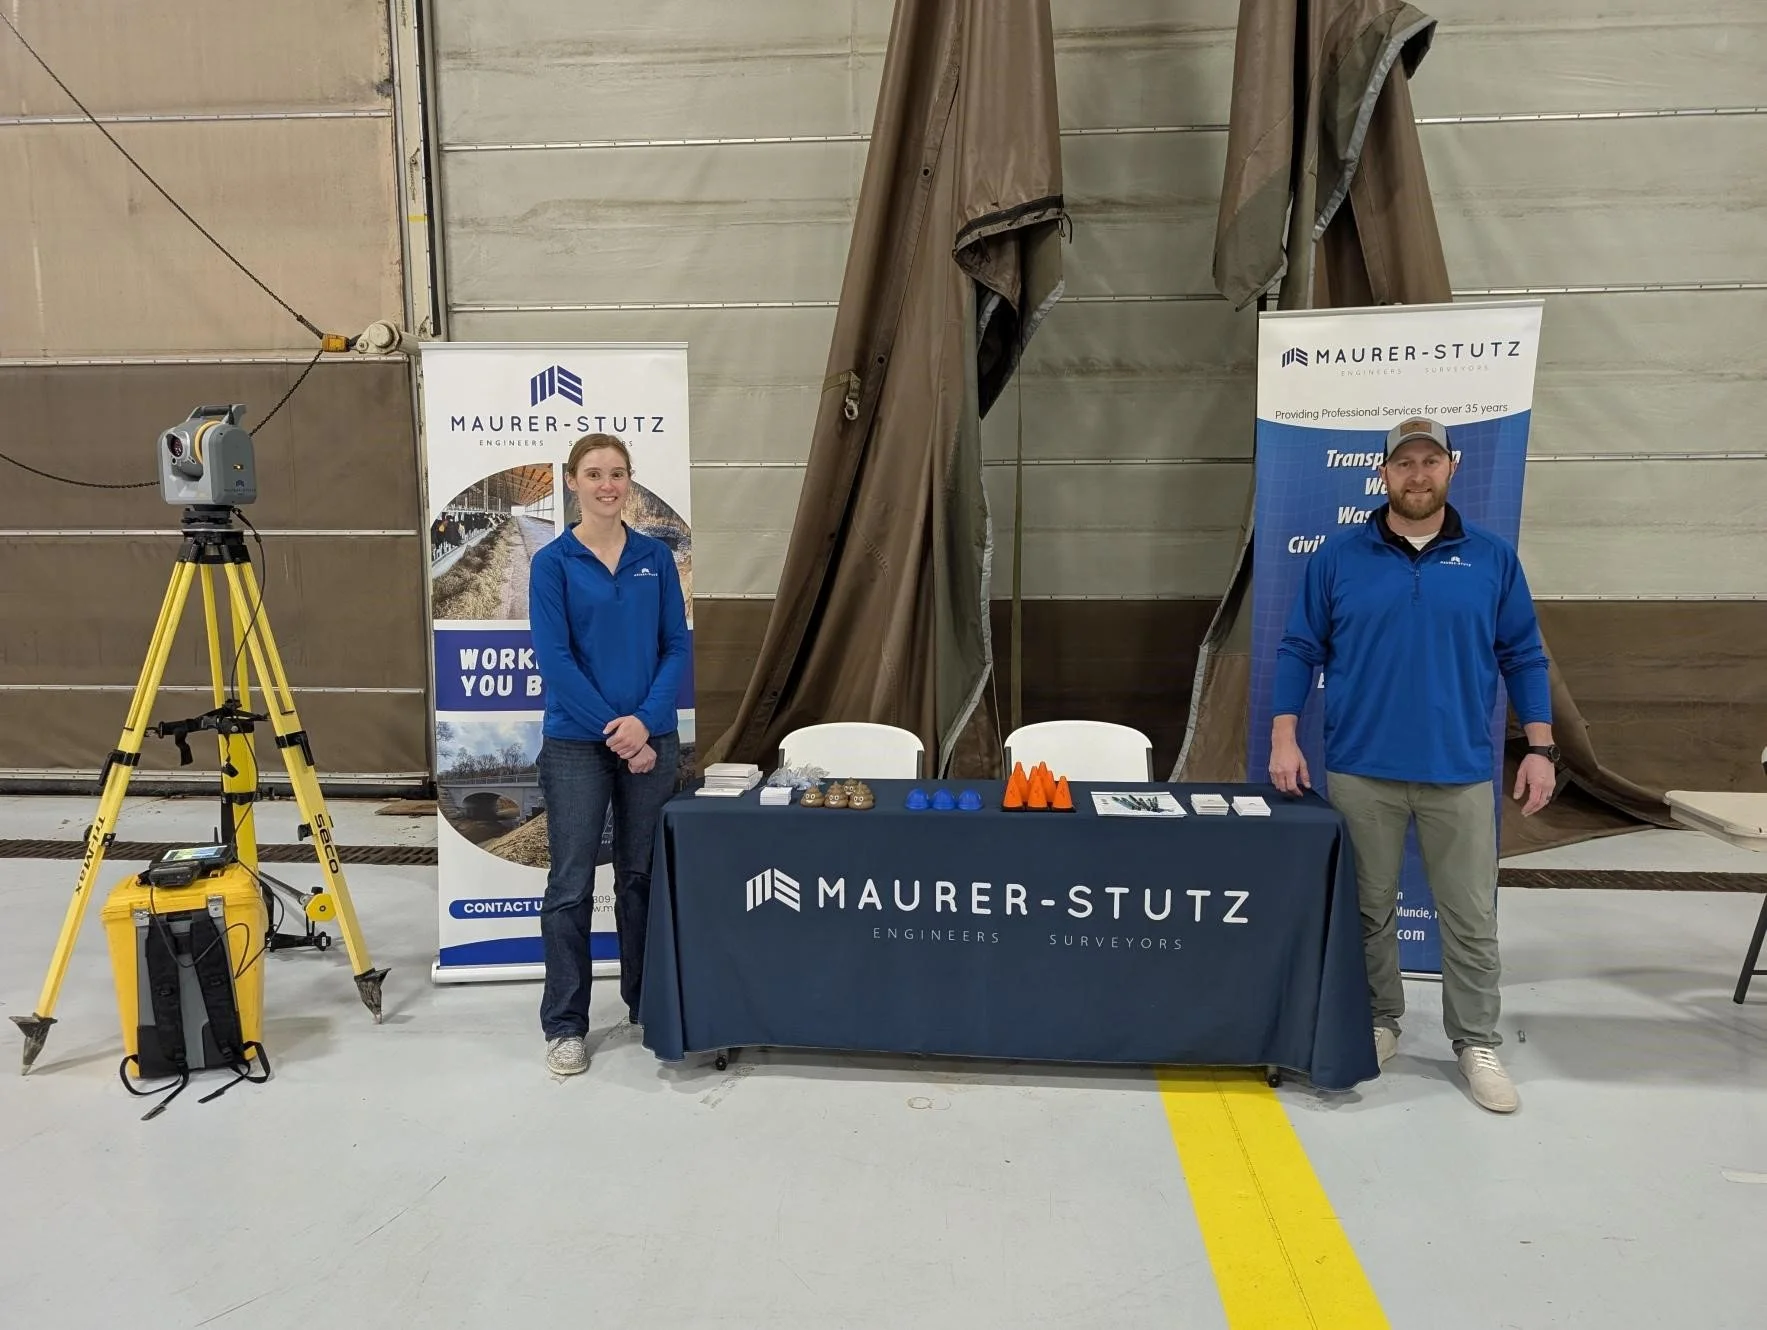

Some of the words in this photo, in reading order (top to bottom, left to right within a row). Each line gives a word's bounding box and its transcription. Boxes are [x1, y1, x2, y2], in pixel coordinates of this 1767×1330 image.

[1316, 341, 1520, 364] MAURER-STUTZ
[1275, 409, 1319, 420] Providing
[1321, 406, 1380, 418] Professional
[1382, 405, 1422, 416] Services
[1425, 404, 1438, 414] for
[1440, 406, 1462, 414] over
[1465, 403, 1478, 413] 35
[1481, 404, 1508, 415] years
[451, 415, 665, 433] MAURER-STUTZ
[479, 439, 544, 447] ENGINEERS
[459, 647, 539, 670] WORK
[460, 674, 513, 697] YOU
[463, 901, 531, 914] CONTACT
[534, 900, 543, 911] U
[817, 876, 1250, 924] MAURER-STUTZ
[873, 927, 1000, 944] ENGINEERS
[1049, 934, 1182, 950] SURVEYORS
